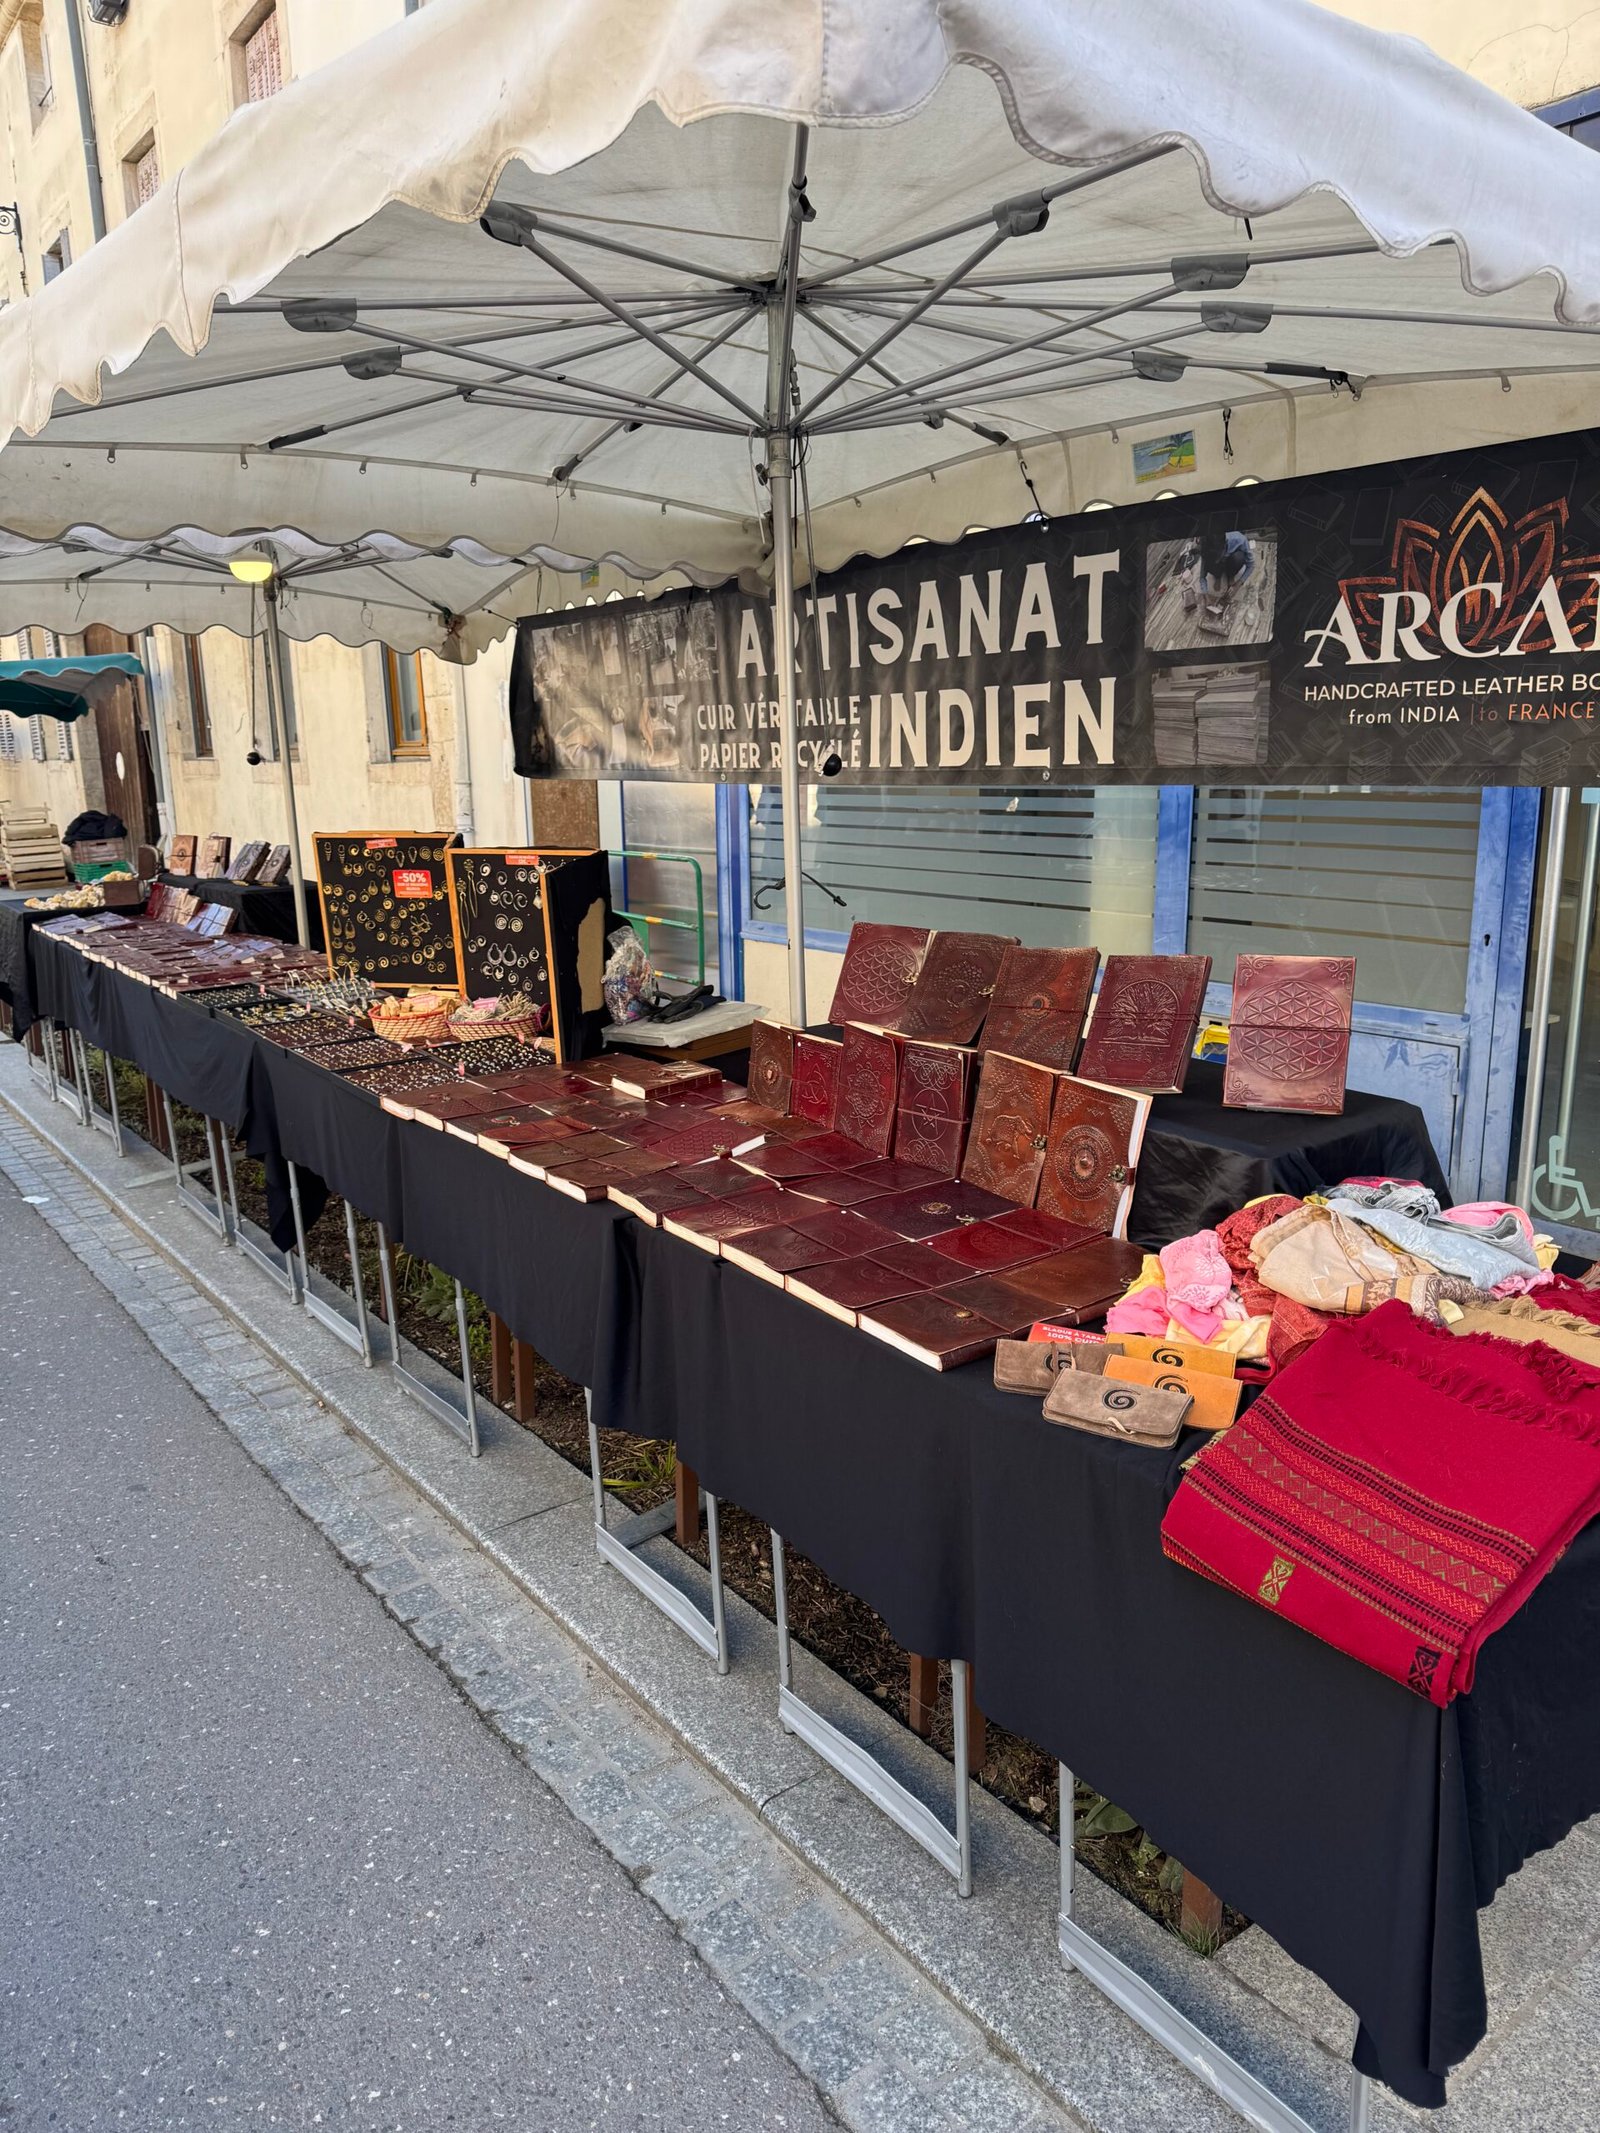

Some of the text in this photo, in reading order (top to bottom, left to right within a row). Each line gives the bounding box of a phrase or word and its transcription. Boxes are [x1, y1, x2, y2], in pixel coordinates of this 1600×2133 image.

[1304, 574, 1600, 667] ARCA
[1304, 679, 1456, 701] HANDCRAFTED
[1462, 674, 1564, 695] LEATHER
[697, 692, 861, 730] CUIR VÉRTABLE
[869, 677, 1117, 769] INDIEN
[1349, 708, 1392, 725] from
[1400, 706, 1460, 723] INDIA
[1508, 701, 1596, 720] FRANCE
[700, 728, 862, 769] PAPIER RCYLÉ
[398, 872, 427, 883] -50%
[1047, 1331, 1073, 1341] 100%
